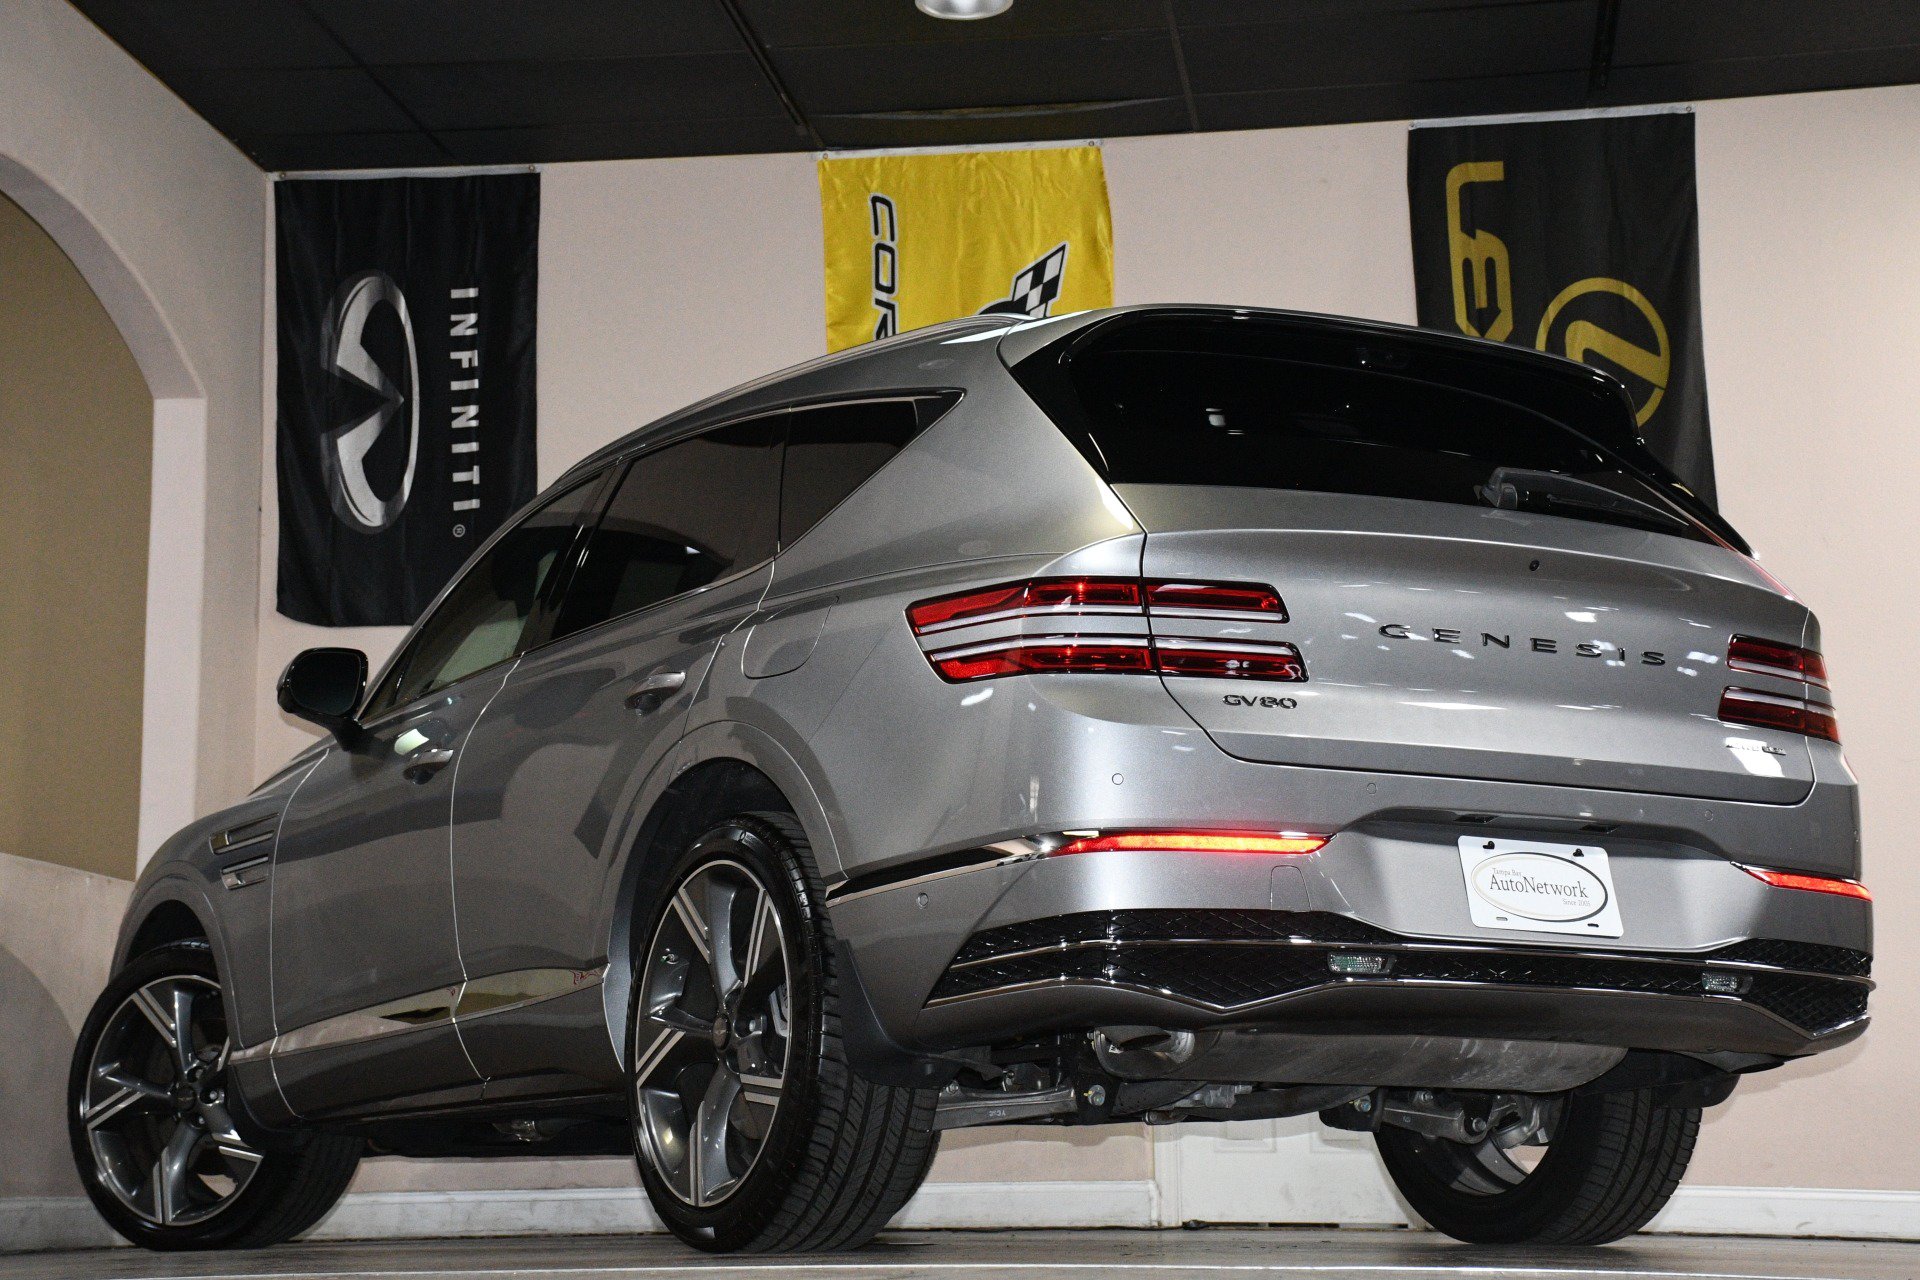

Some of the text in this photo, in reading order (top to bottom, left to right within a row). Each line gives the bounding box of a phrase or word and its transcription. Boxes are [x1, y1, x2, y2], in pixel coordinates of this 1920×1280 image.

[450, 287, 481, 511] INFINITI
[1378, 623, 1666, 666] GENESIS
[1222, 694, 1298, 710] GV80
[1490, 874, 1588, 898] AutoNetwork
